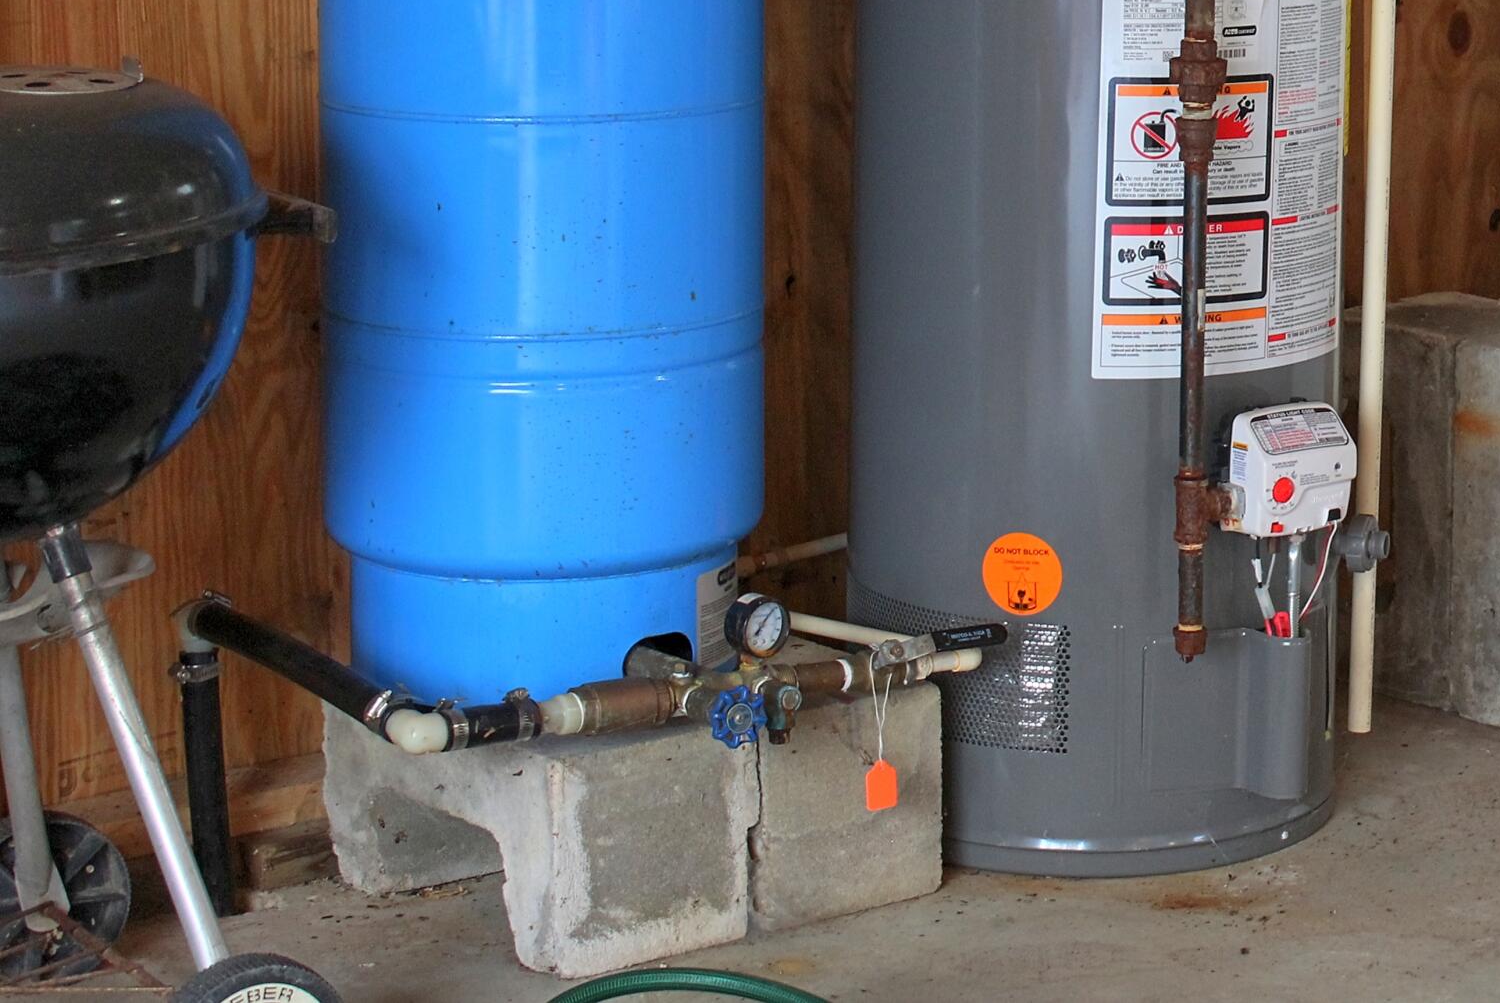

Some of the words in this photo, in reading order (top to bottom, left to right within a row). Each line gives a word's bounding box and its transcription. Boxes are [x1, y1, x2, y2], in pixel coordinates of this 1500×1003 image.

[1006, 547, 1022, 555] NOT
[1023, 548, 1050, 556] BLOCK
[230, 987, 294, 1003] EBER
